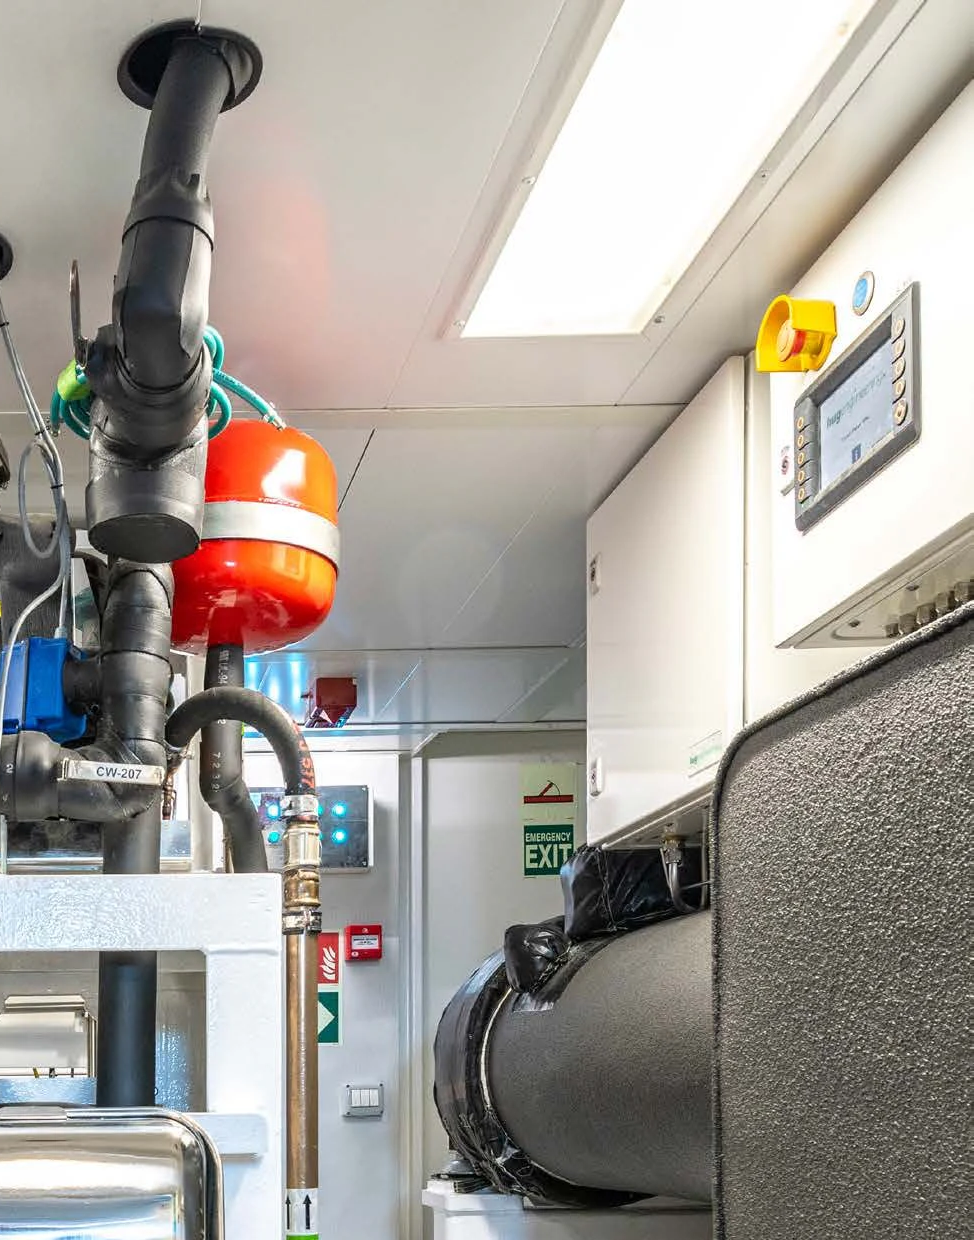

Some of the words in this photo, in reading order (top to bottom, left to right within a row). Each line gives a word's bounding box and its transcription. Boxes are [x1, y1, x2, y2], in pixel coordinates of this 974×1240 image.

[96, 766, 142, 779] CW-207
[525, 832, 571, 842] EMERGENCY
[525, 843, 572, 868] EXIT
